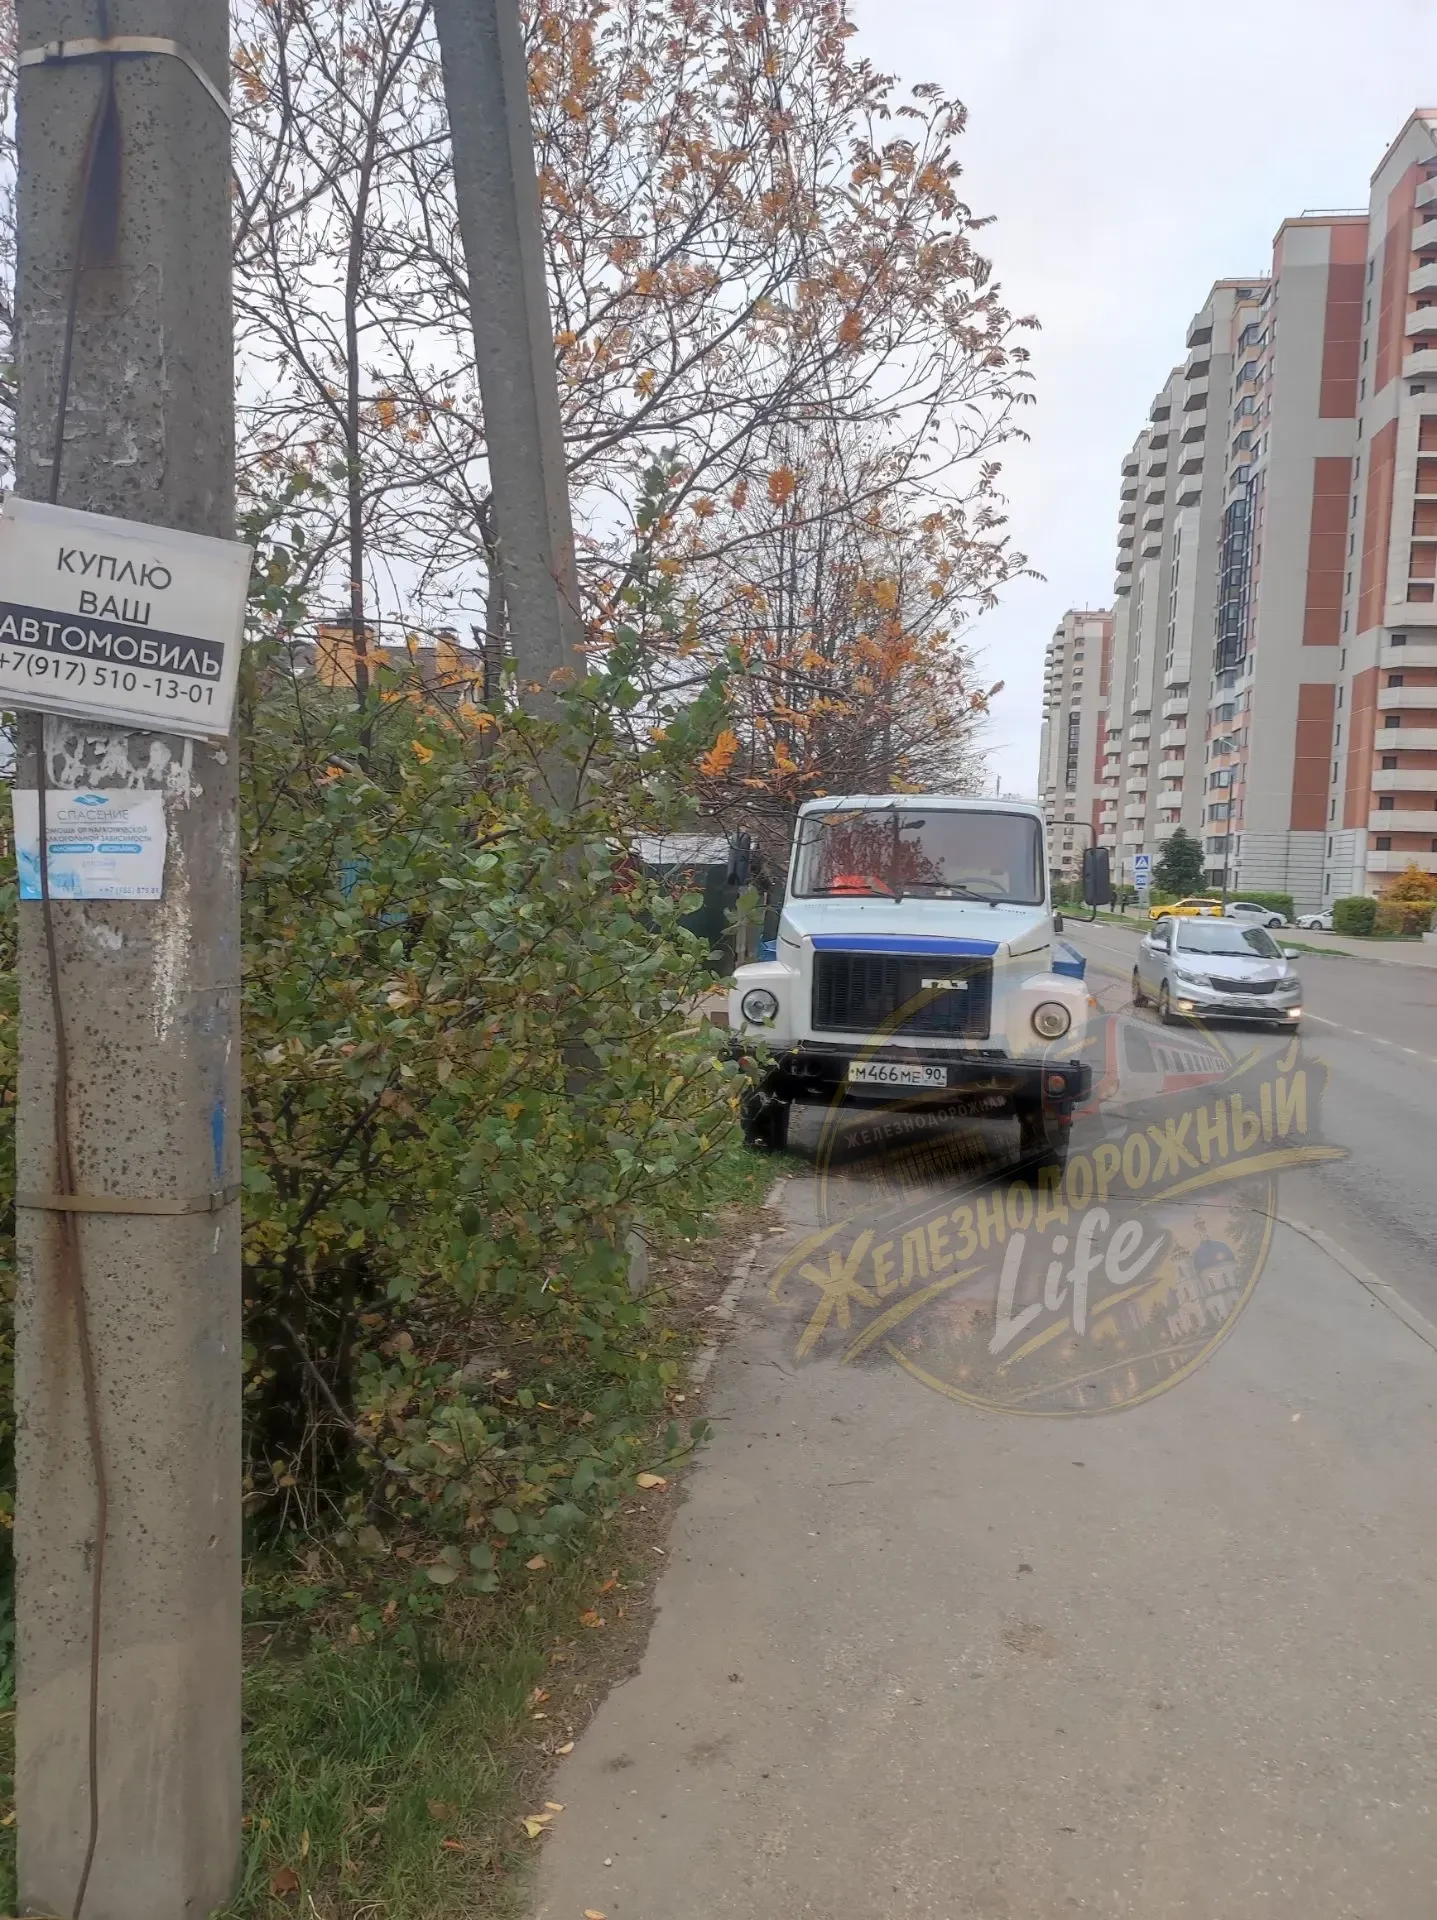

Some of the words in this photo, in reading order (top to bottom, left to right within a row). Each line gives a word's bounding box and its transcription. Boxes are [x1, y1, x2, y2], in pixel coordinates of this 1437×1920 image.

[57, 547, 172, 590] КУПЛЮ
[79, 590, 151, 625] ВАШ
[0, 615, 220, 676] АВТОМОБИЛЬ
[0, 651, 87, 686] +7(917)
[93, 667, 137, 692] 510
[143, 678, 213, 705] -13-01
[57, 809, 129, 821] СПАСЕНИЕ
[925, 1068, 941, 1080] 90
